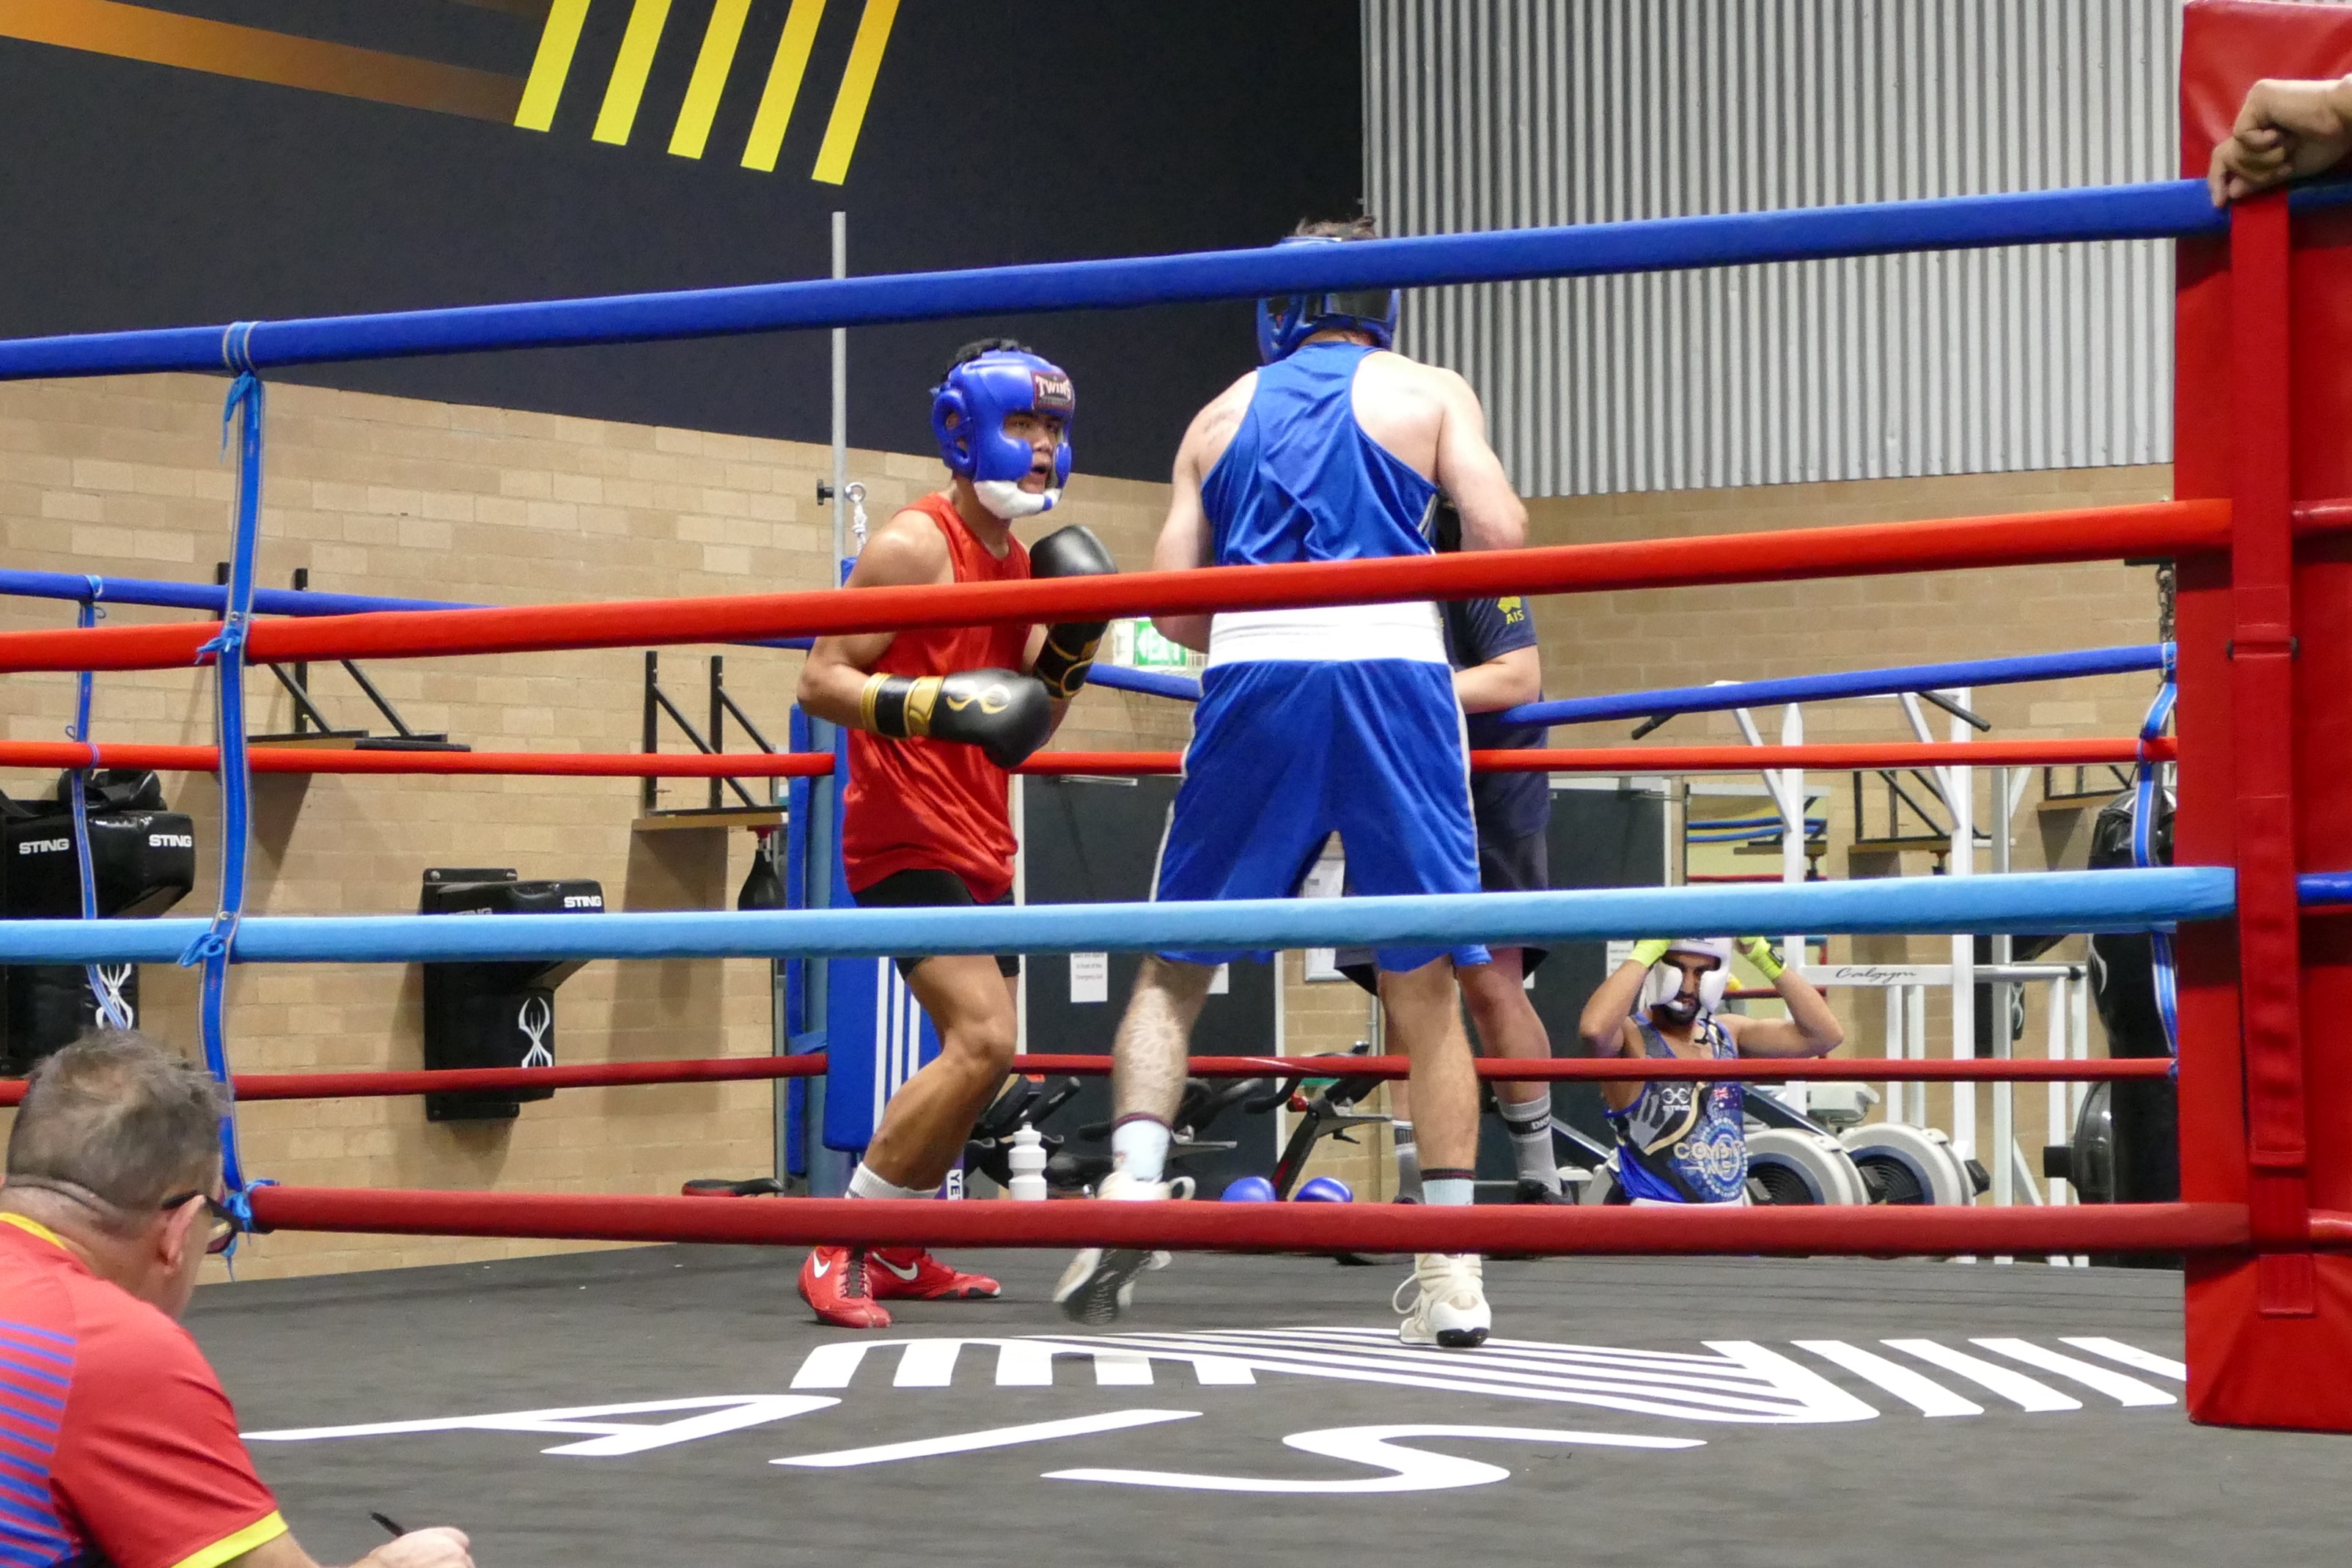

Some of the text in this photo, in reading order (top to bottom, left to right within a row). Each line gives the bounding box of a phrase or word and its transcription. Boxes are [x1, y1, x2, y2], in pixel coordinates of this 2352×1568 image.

[1506, 609, 1525, 625] AIS
[19, 838, 70, 855] STING
[149, 834, 192, 847] STING
[564, 895, 602, 908] STING
[1835, 967, 1916, 984] Calgym
[950, 1171, 960, 1200] YE
[238, 1394, 1709, 1493] AIS
